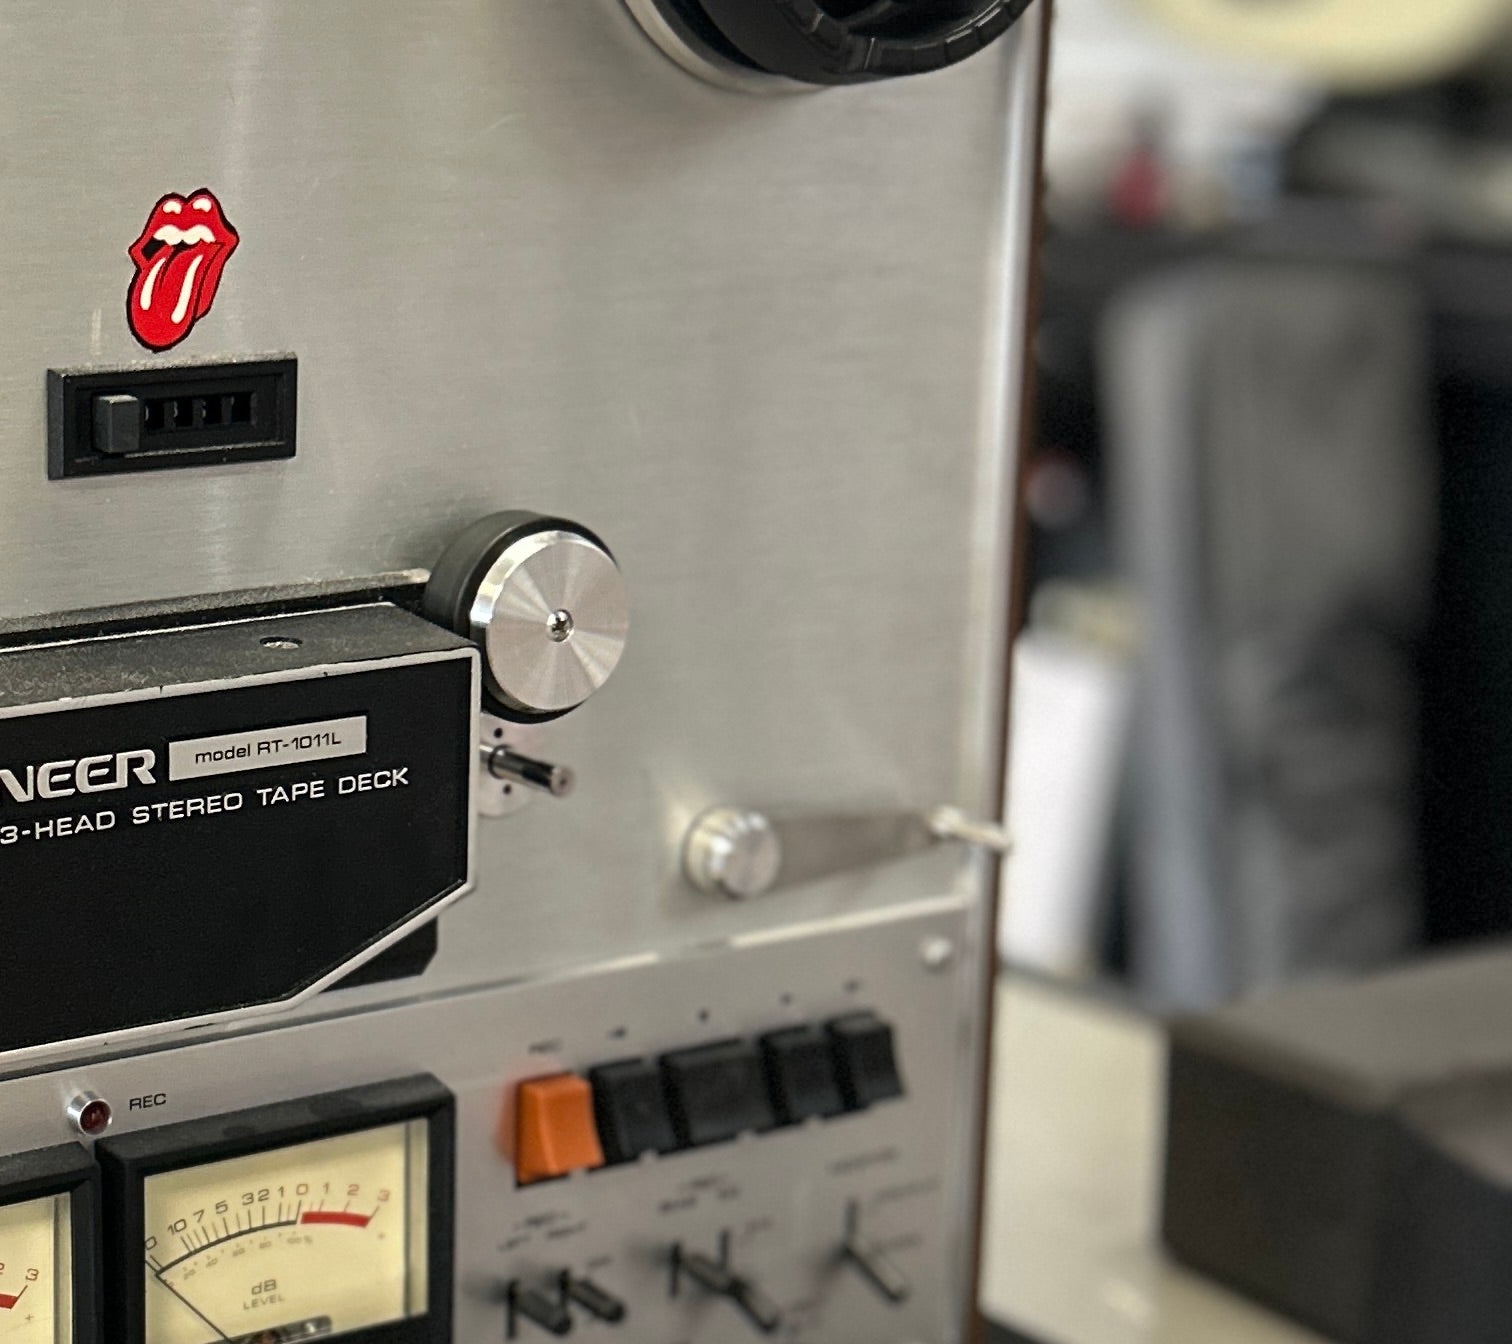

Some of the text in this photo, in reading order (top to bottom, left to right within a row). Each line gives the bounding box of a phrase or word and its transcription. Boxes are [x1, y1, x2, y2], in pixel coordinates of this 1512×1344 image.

[195, 731, 342, 764] model RT-1011L
[0, 810, 117, 846] 3-HEAD
[132, 792, 244, 825] STEREO
[256, 779, 326, 807] TAPE
[337, 767, 410, 796] DECK
[128, 1092, 168, 1112] REC
[167, 1218, 187, 1236] 10
[193, 1210, 205, 1224] 7
[215, 1200, 229, 1215] 5
[278, 1186, 285, 1198] 1
[296, 1183, 309, 1196] 0
[323, 1182, 330, 1194] 1
[347, 1183, 360, 1197] 2
[378, 1189, 391, 1202] 3
[26, 1268, 40, 1282] 3
[251, 1279, 277, 1296] dB
[243, 1295, 284, 1311] LEVEL
